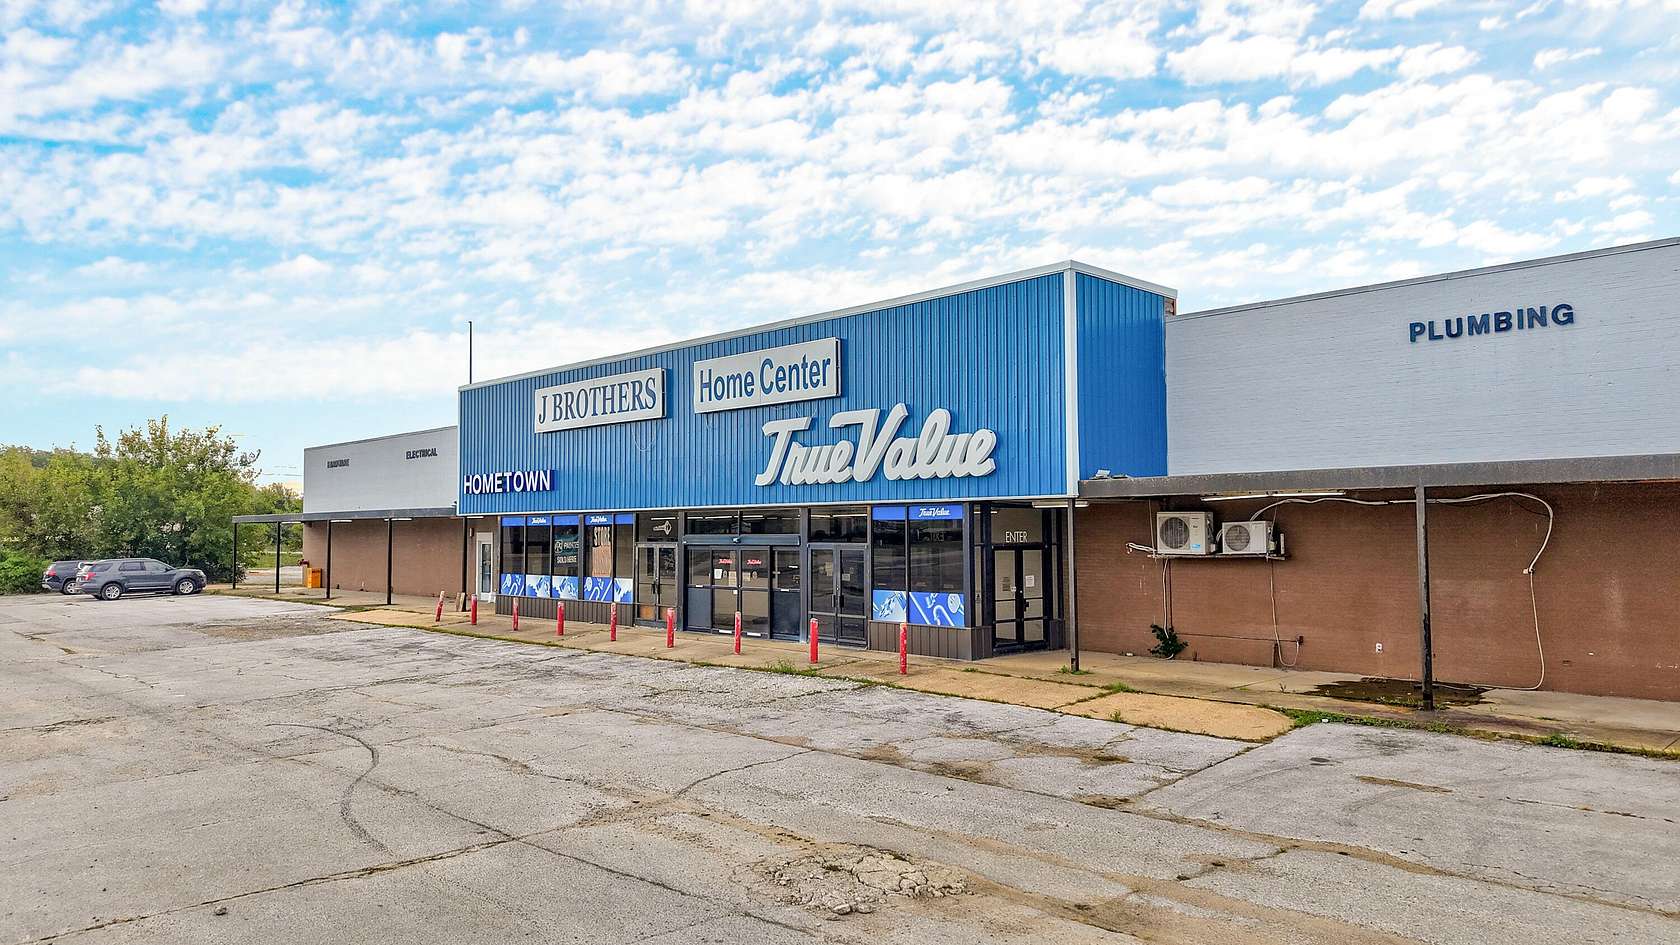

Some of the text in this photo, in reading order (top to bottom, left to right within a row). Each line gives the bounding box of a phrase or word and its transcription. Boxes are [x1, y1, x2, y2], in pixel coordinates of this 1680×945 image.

[1409, 303, 1574, 343] PLUMBING
[699, 353, 832, 403] Home Center
[538, 376, 657, 425] J BROTHERS
[405, 448, 438, 460] ELECTRICAL
[463, 469, 551, 495] HOMETOWN
[1005, 531, 1028, 543] ENTER
